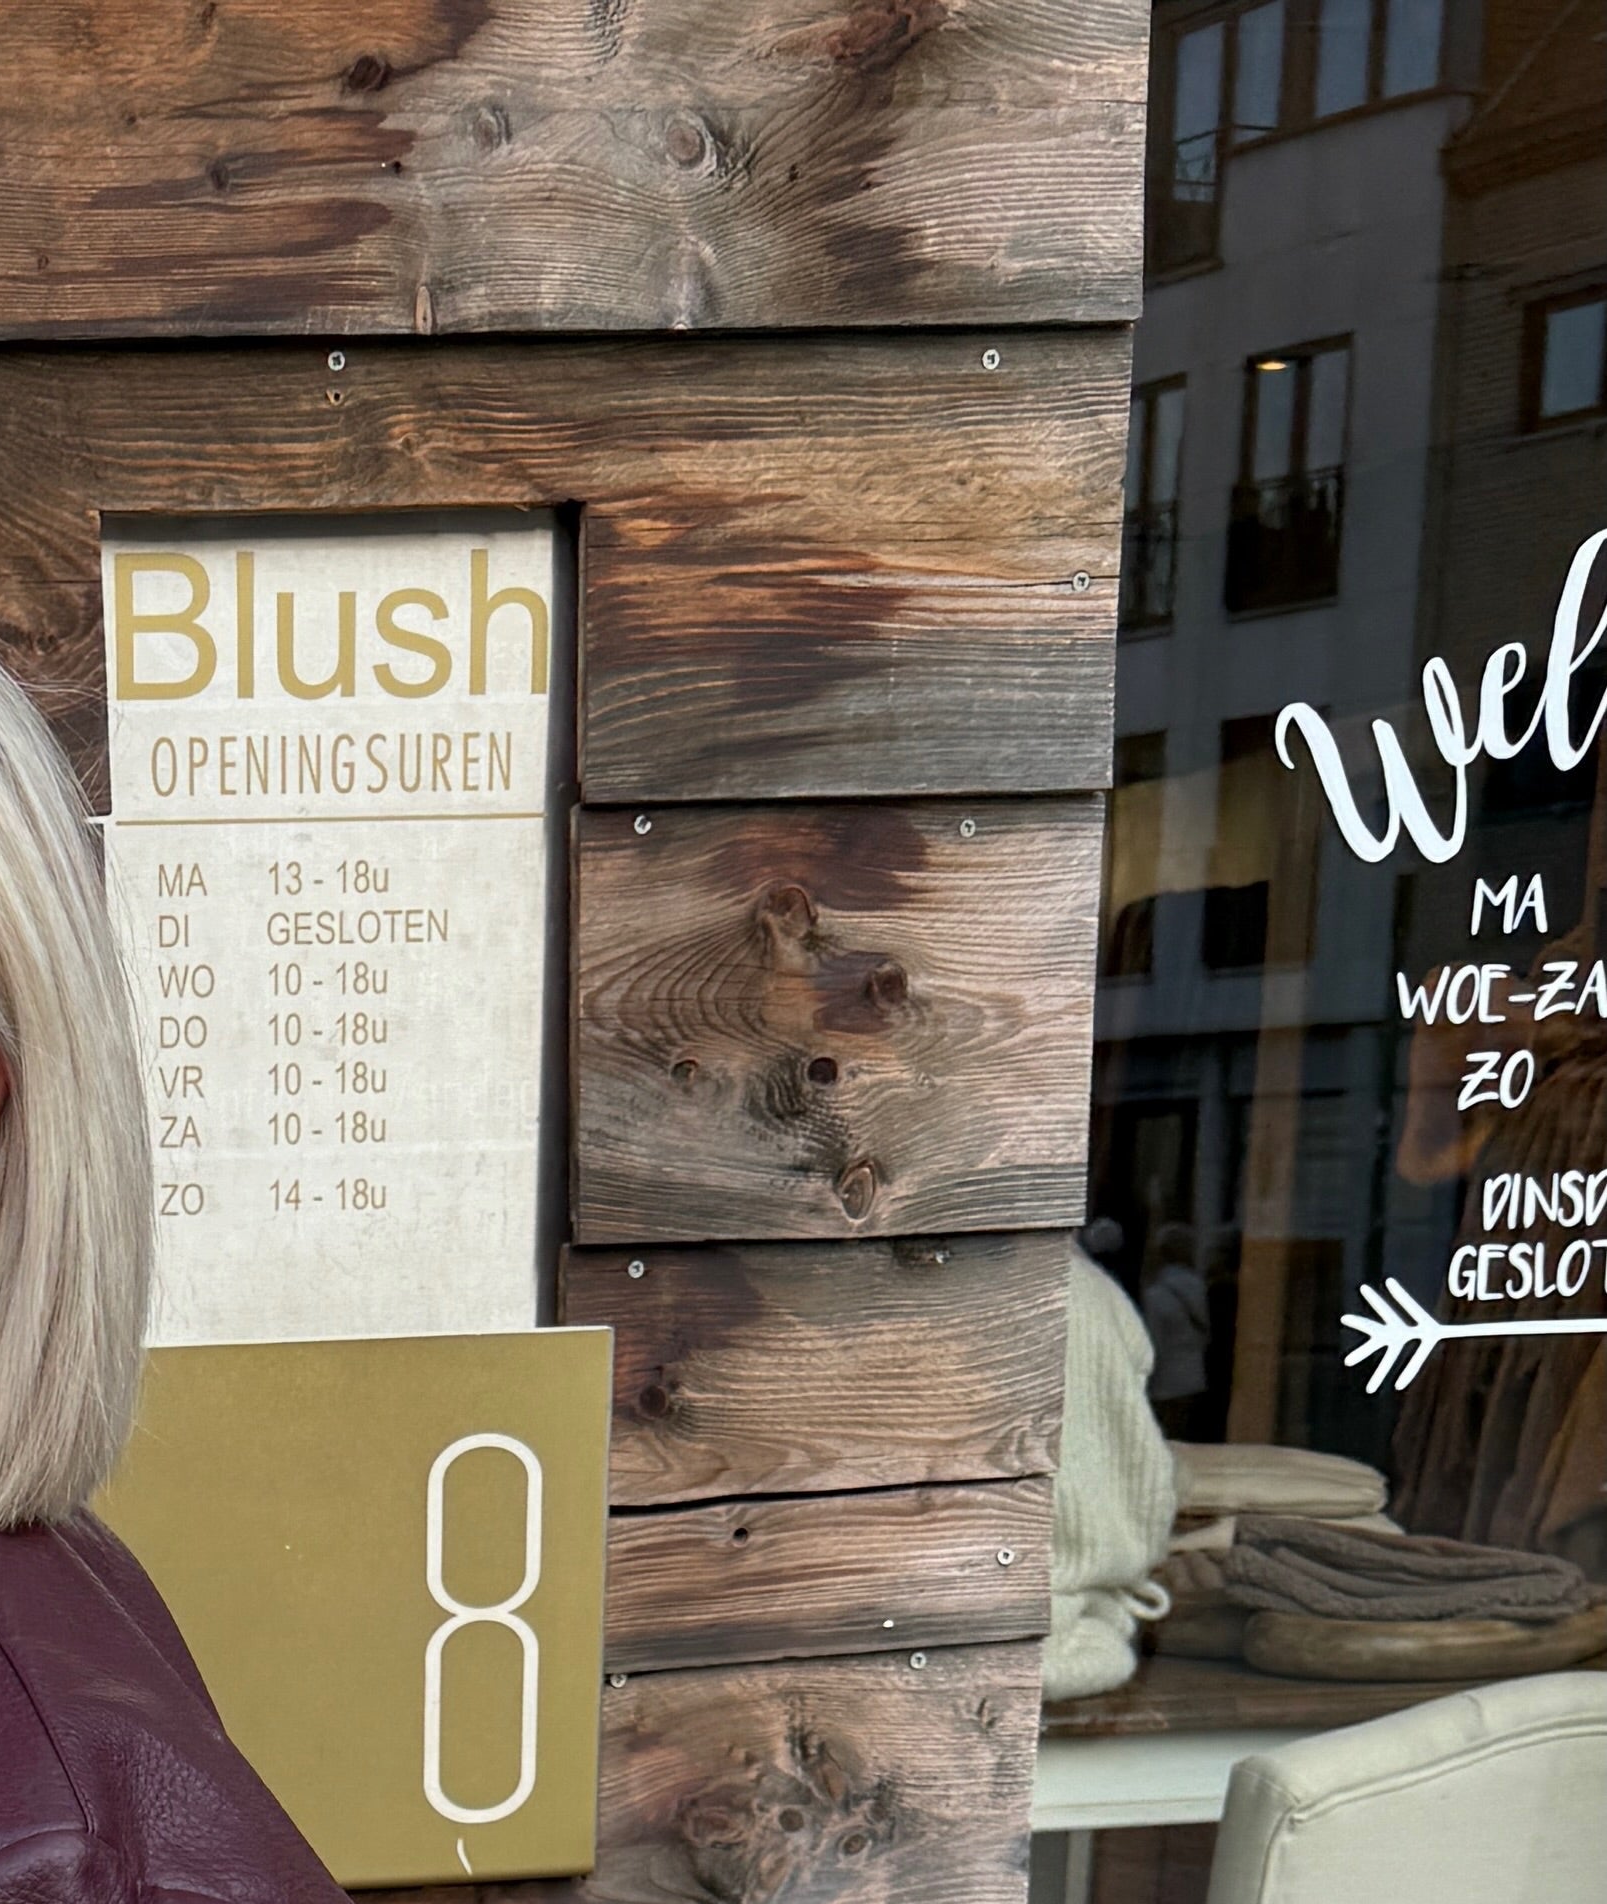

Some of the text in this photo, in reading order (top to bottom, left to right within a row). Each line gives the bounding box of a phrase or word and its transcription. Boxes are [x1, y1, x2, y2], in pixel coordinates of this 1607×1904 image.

[113, 548, 548, 701] Blush
[150, 731, 513, 798] OPENINGSUREN
[157, 862, 209, 898] MA
[267, 860, 303, 897] 13
[335, 858, 390, 895] 18u
[1471, 874, 1548, 935] MA
[158, 908, 449, 949] DI GESLOTEN
[157, 963, 216, 999] WO
[268, 961, 303, 997] 10
[335, 960, 389, 996] 18u
[1397, 960, 1607, 1025] WOE-ZA
[159, 1014, 208, 1050] DO
[268, 1012, 303, 1047] 10
[335, 1011, 389, 1047] 18u
[157, 1064, 205, 1100] VR
[267, 1061, 302, 1097] 10
[334, 1060, 387, 1095] 18u
[1457, 1049, 1535, 1111] ZO
[158, 1114, 203, 1150] ZA
[267, 1111, 302, 1146] 10
[334, 1109, 387, 1144] 18u
[158, 1182, 205, 1217] ZO
[269, 1178, 302, 1212] 14
[335, 1177, 387, 1211] 18u
[423, 1433, 543, 1824] 8
